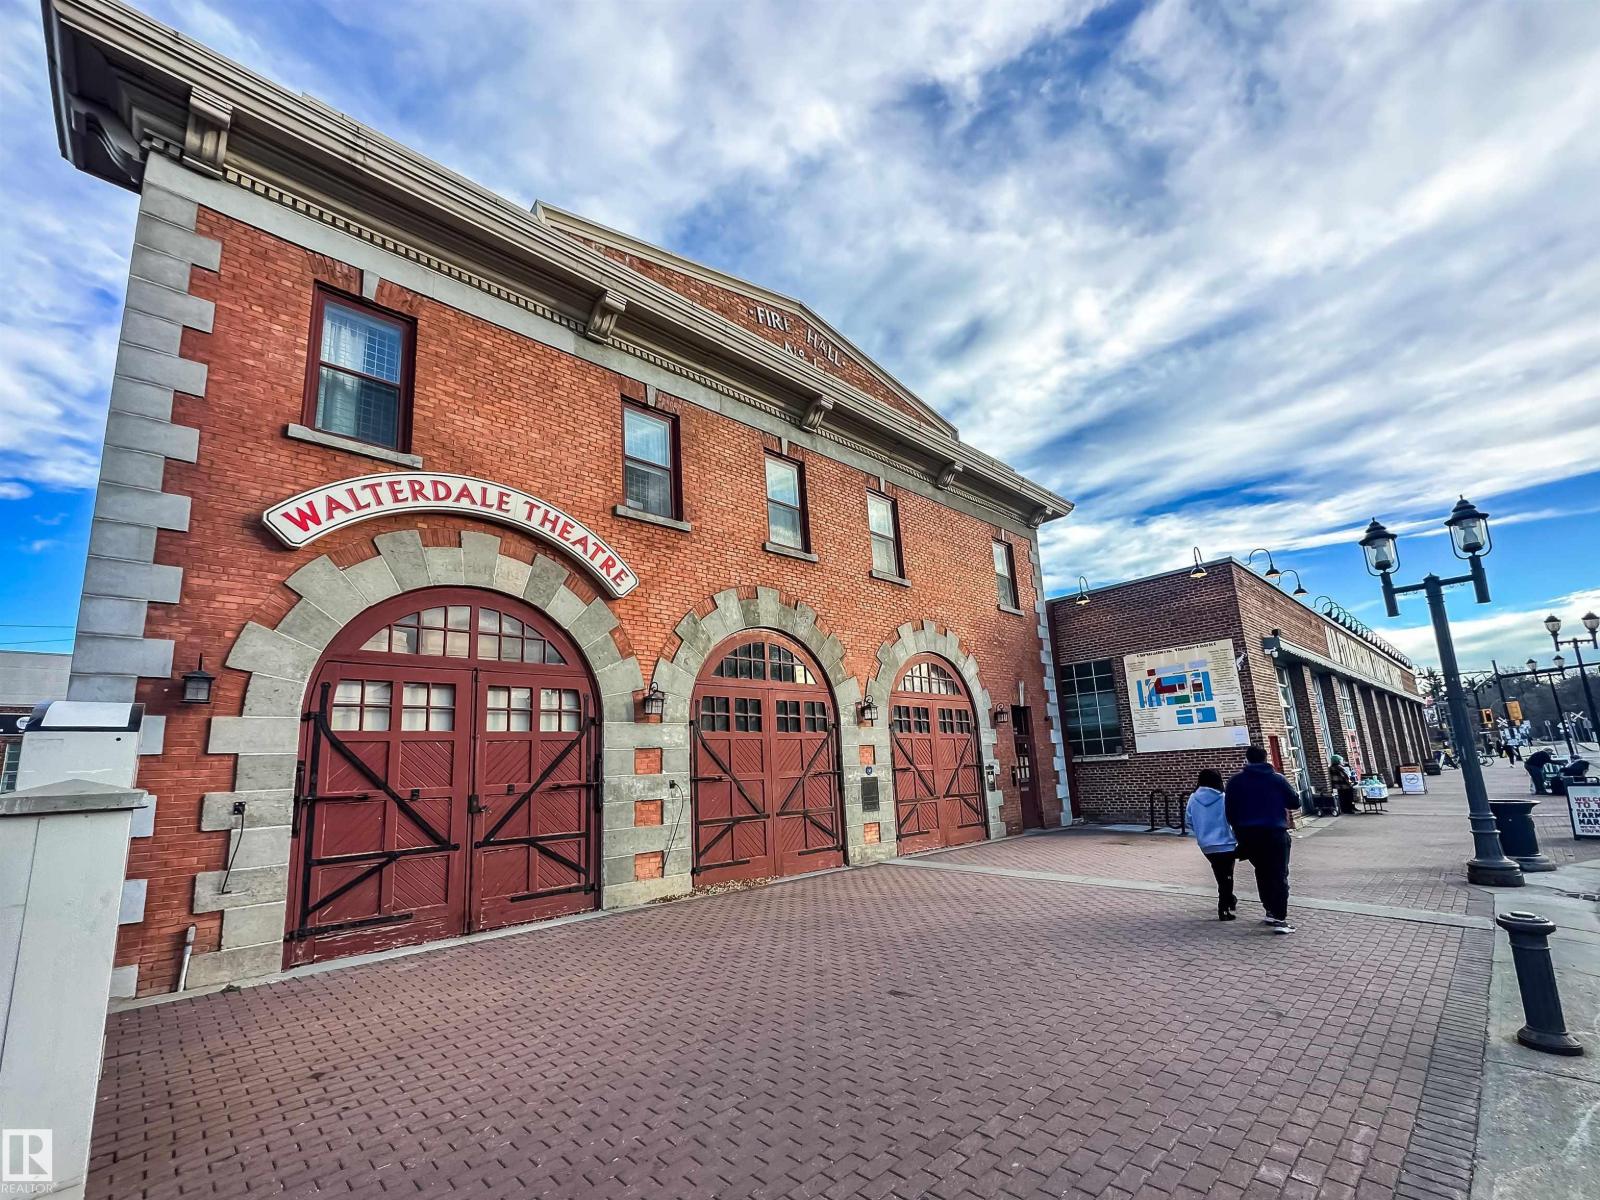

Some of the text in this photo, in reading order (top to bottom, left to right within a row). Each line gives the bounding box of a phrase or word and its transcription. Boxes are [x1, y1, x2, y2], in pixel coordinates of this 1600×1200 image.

[756, 306, 842, 367] FIRE HALL
[282, 479, 629, 587] WALTERDALE THEATRE
